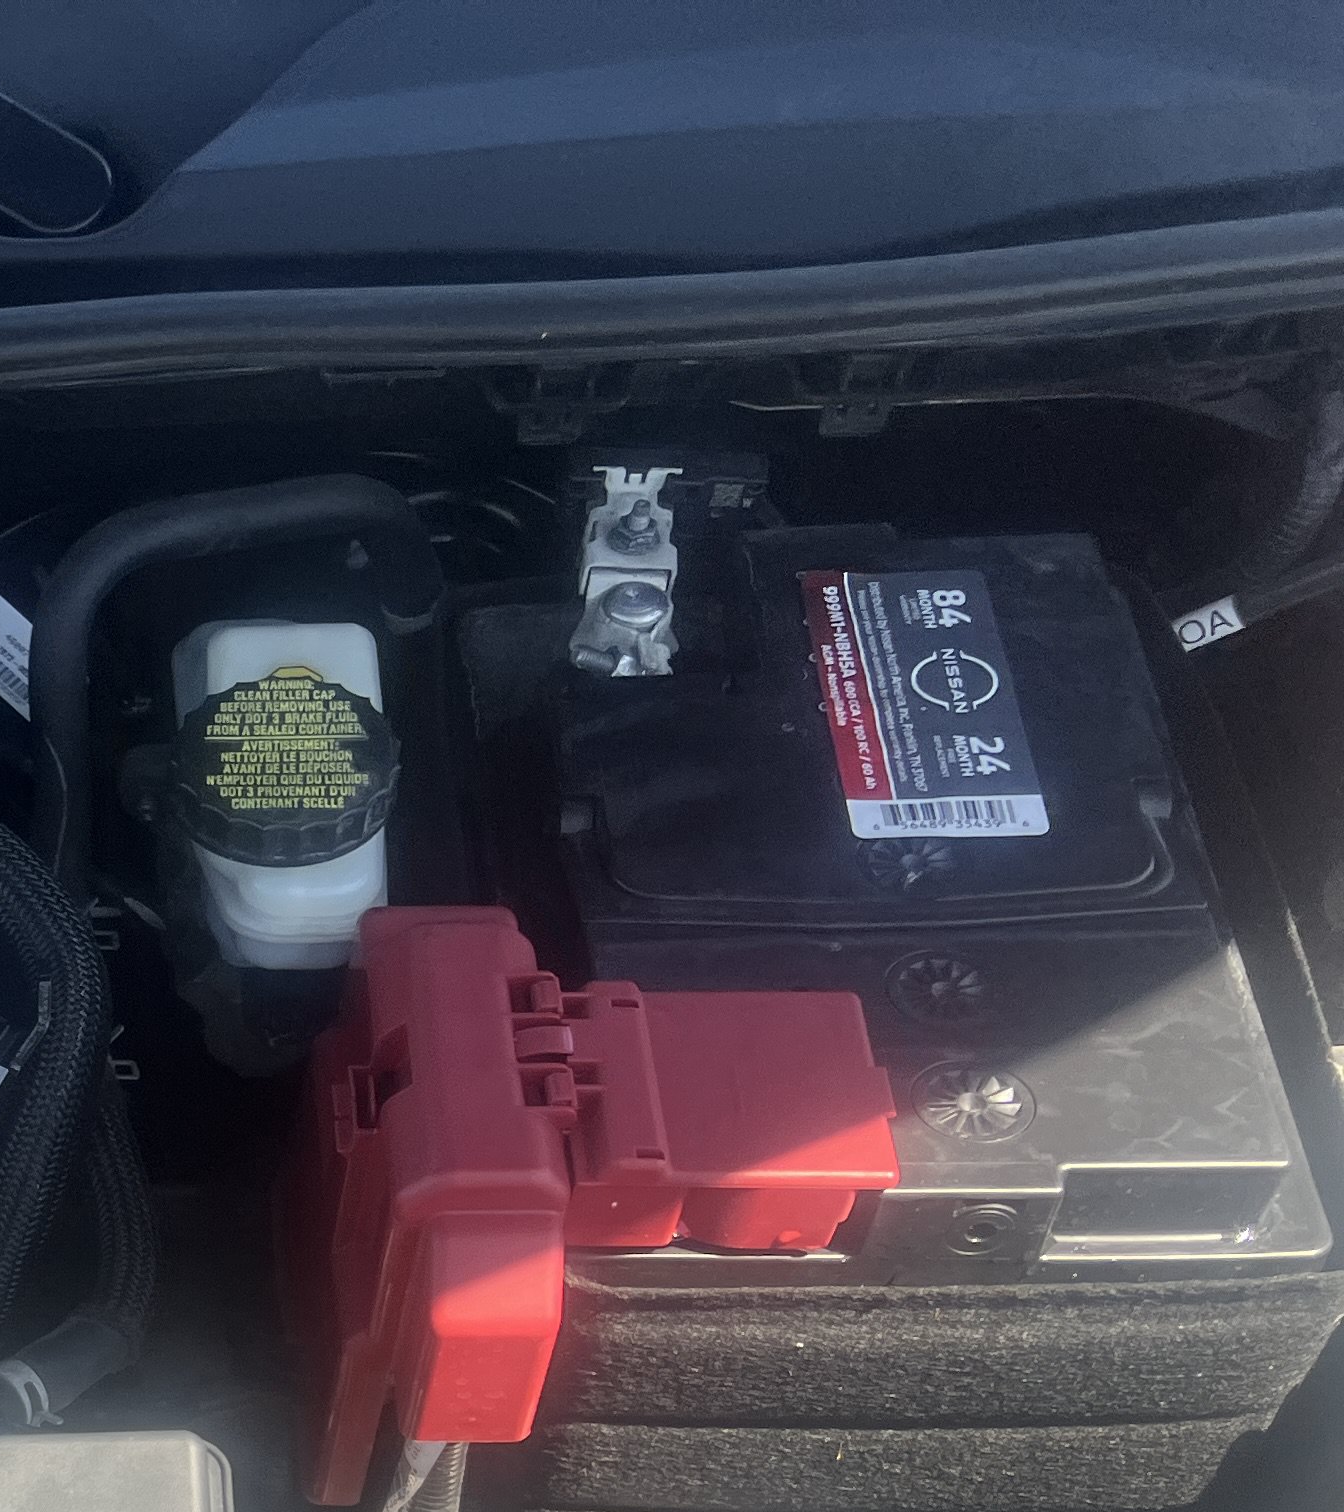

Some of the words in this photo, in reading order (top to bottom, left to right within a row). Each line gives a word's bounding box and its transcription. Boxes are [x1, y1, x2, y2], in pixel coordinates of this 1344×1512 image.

[916, 589, 938, 628] MONTH
[931, 590, 972, 628] 84
[820, 645, 835, 666] AGM
[940, 648, 969, 714] NISSAN
[822, 586, 857, 678] 999M1-NBH5A
[850, 700, 861, 717] CCA
[857, 741, 871, 754] RC
[864, 776, 877, 790] Ah
[234, 691, 270, 700] CLEAN
[273, 691, 310, 700] FILLER
[313, 690, 336, 700] CAP
[827, 673, 849, 727] Nonspillable
[220, 702, 264, 712] BEFORE
[329, 701, 351, 711] USE
[214, 714, 241, 723] ONLY
[245, 713, 267, 723] DOT
[272, 713, 279, 723] 3
[285, 713, 322, 723] BRAKE
[326, 712, 358, 722] FLUID
[207, 725, 239, 735] FROM
[242, 725, 250, 735] A
[254, 725, 296, 735] SEALED
[242, 741, 339, 751] AVERTISSEMENT:
[221, 752, 280, 762] NETTOYER
[283, 752, 297, 761] LE
[300, 751, 352, 761] BOUCHON
[952, 735, 975, 777] MONTH
[969, 737, 1011, 775] 24
[223, 764, 262, 773] AVANT
[266, 763, 280, 773] DE
[283, 763, 296, 773] LE
[206, 775, 277, 785] N'EMPLOYER
[280, 775, 303, 785] QUE
[306, 774, 321, 784] DU
[220, 787, 243, 796] DOT
[247, 787, 254, 796] 3
[257, 786, 326, 796] PROVENANT
[231, 798, 299, 809] CONTENANT
